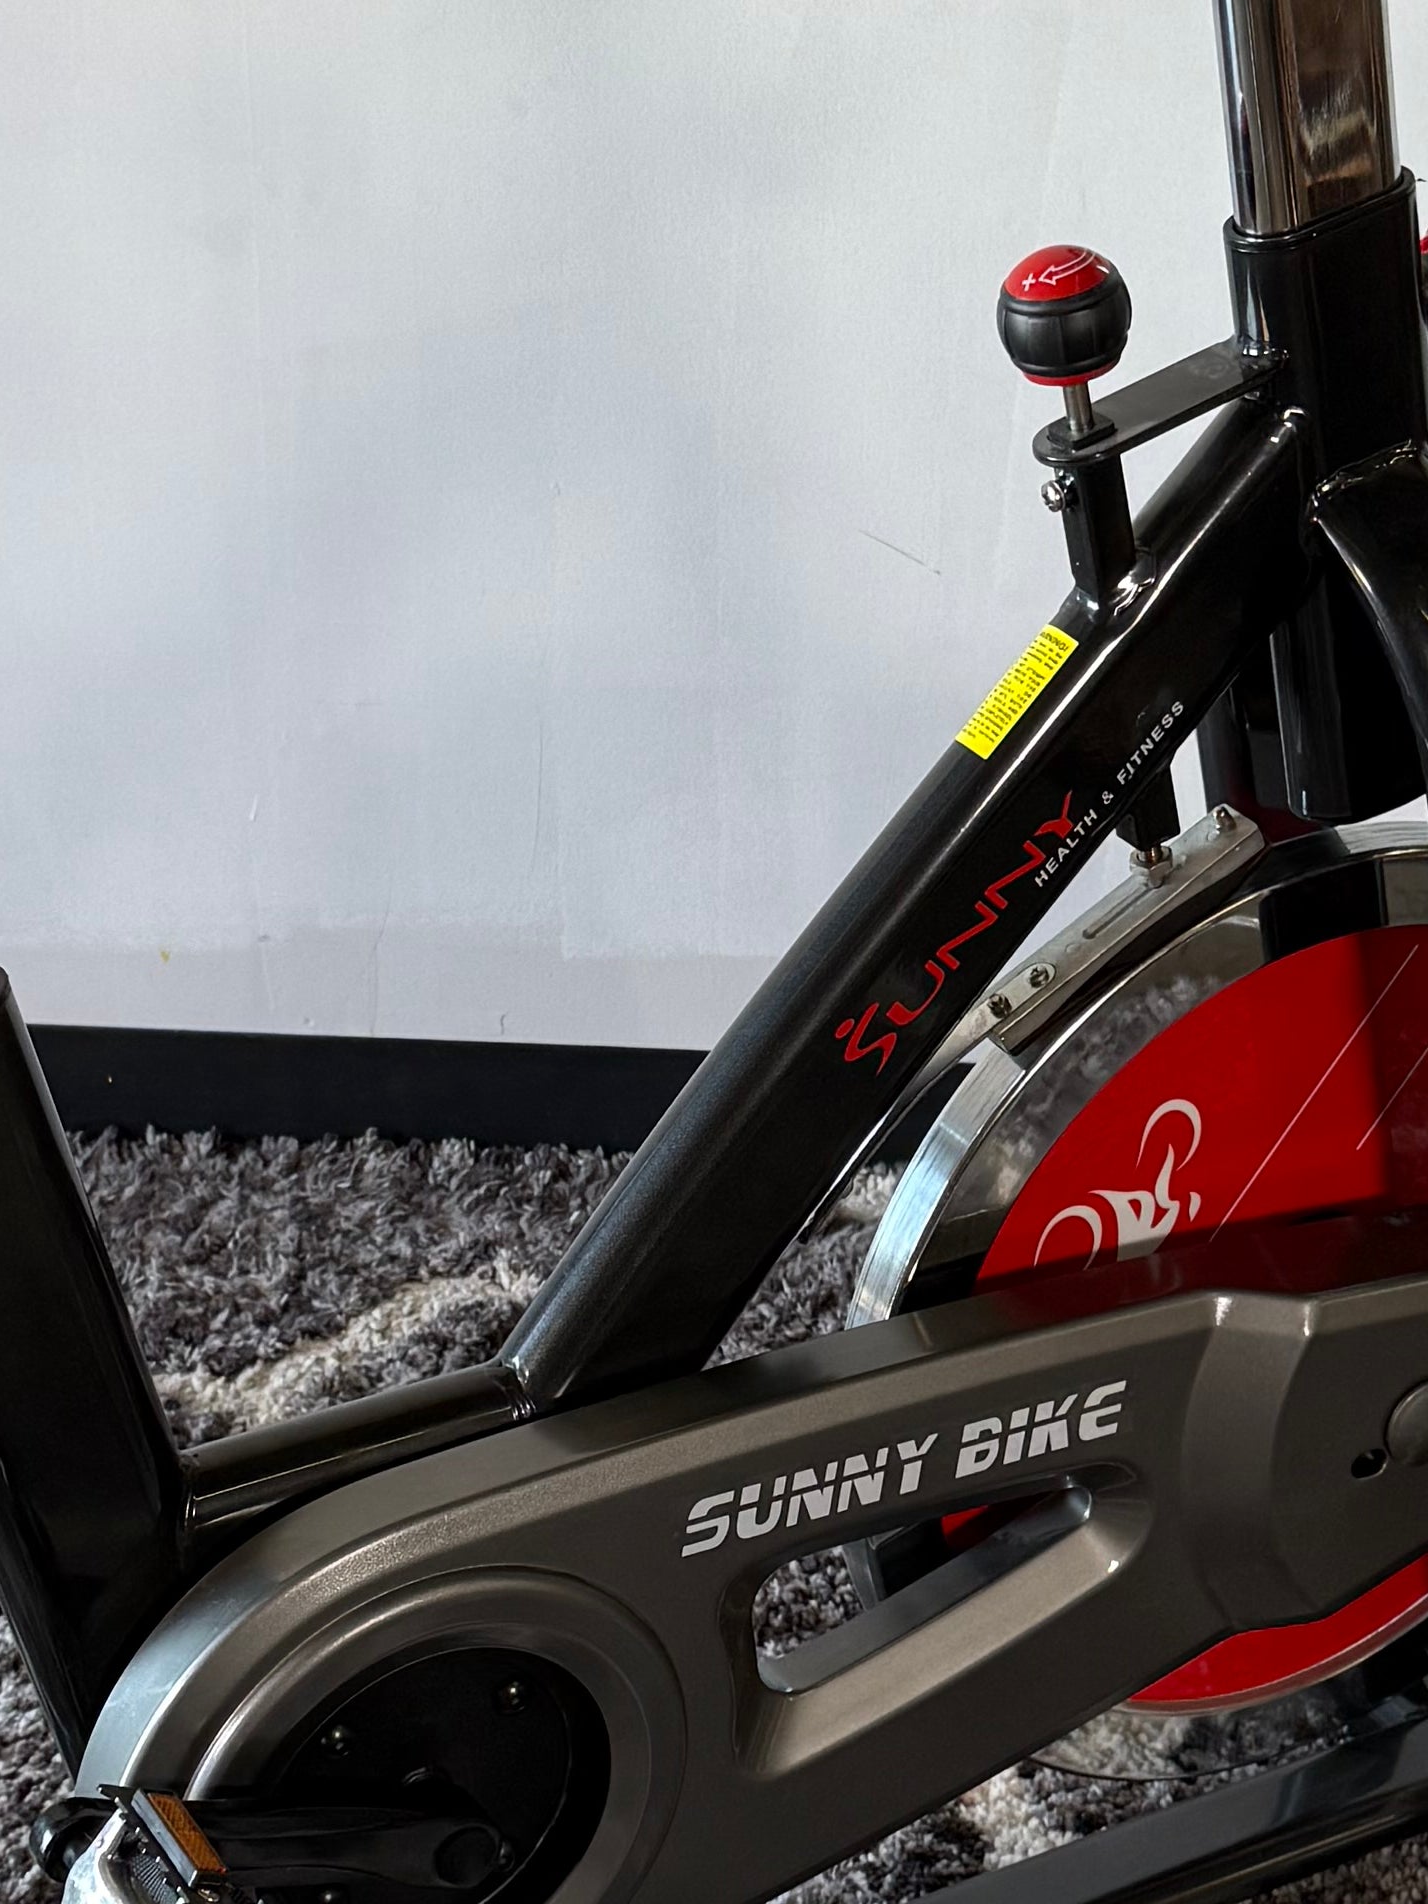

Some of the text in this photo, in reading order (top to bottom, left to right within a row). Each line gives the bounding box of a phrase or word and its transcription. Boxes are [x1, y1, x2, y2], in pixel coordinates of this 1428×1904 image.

[1034, 699, 1185, 887] HEALTH & FITNESS
[835, 789, 1073, 1076] SUNNY
[681, 1380, 1127, 1558] SUNNY BIKE
